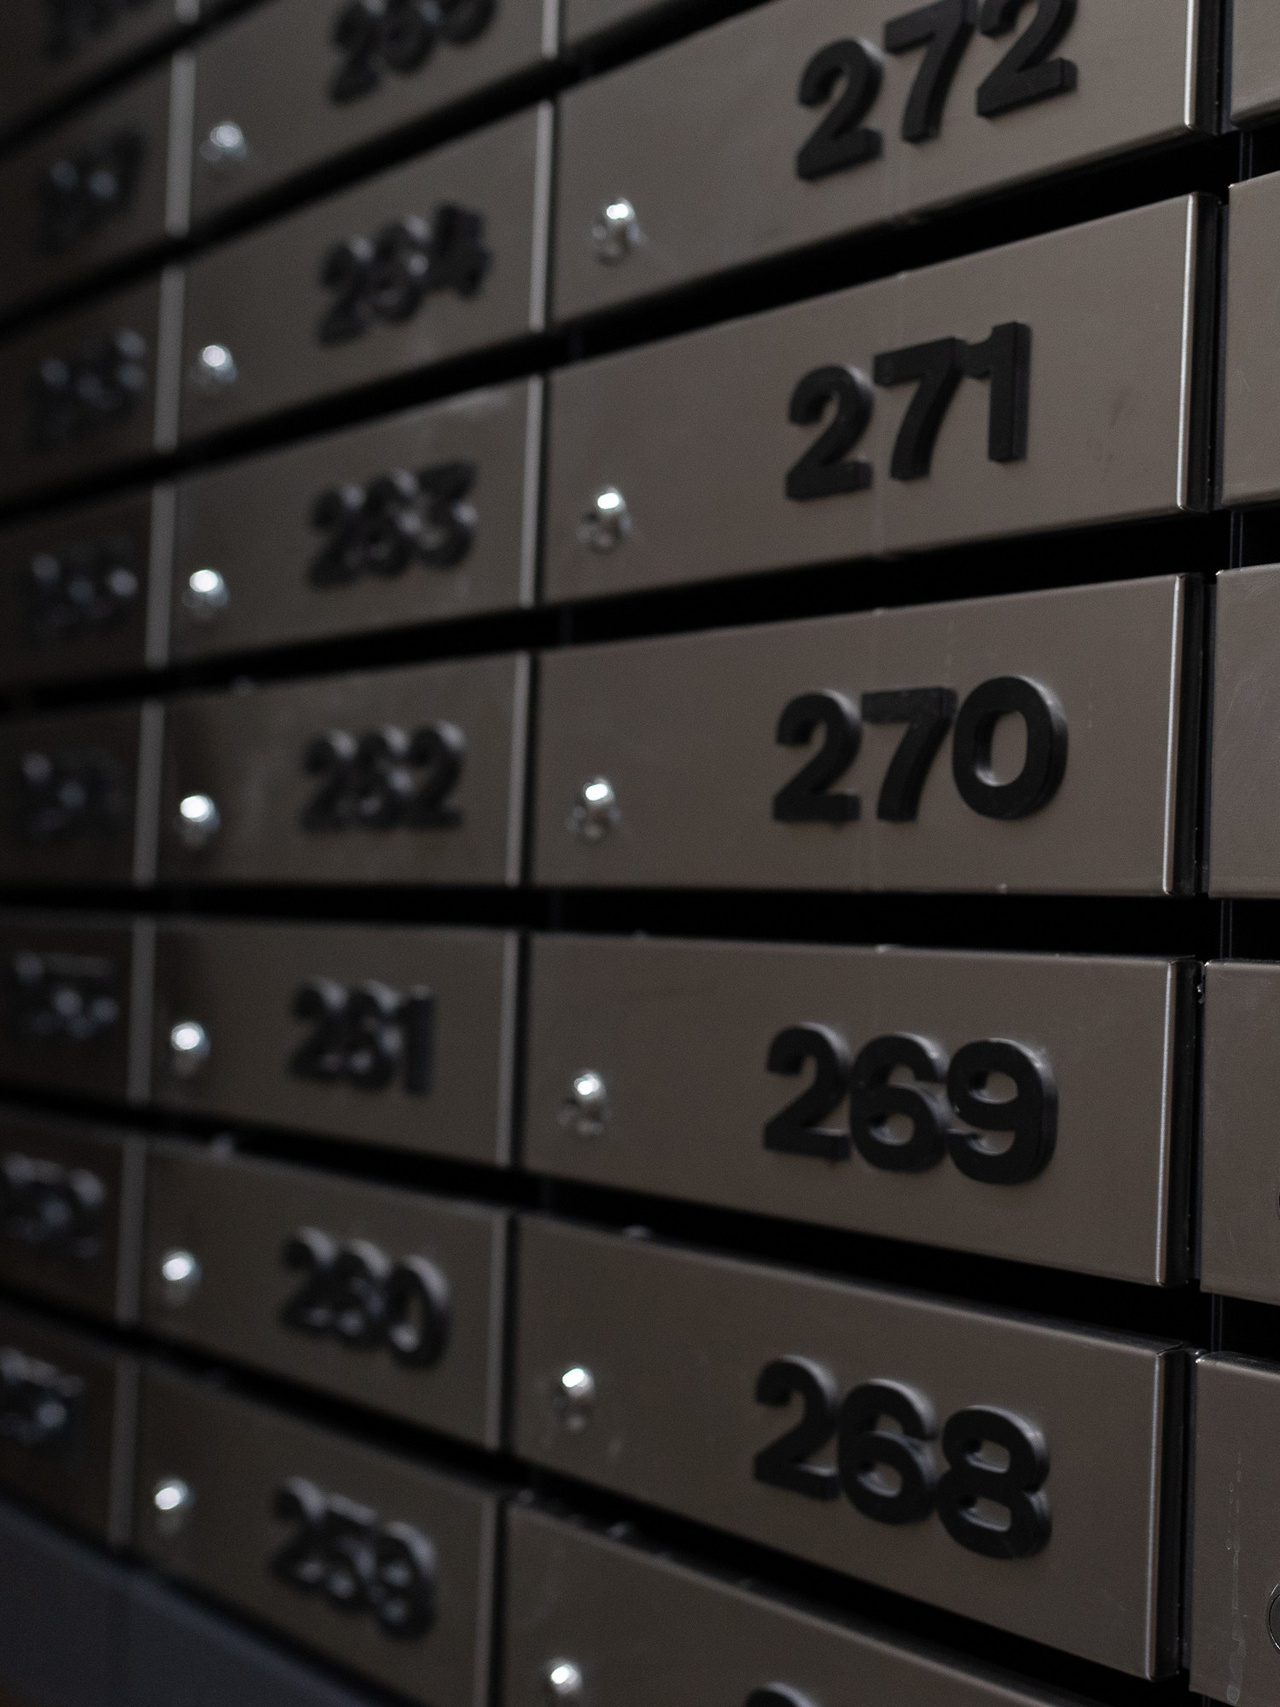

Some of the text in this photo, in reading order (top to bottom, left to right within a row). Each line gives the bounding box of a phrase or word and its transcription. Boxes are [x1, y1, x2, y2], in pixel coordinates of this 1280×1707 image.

[796, 0, 1079, 181] 272
[786, 321, 1032, 500] 271
[772, 675, 1069, 822] 270
[762, 1021, 1059, 1185] 269
[752, 1353, 1053, 1560] 268
